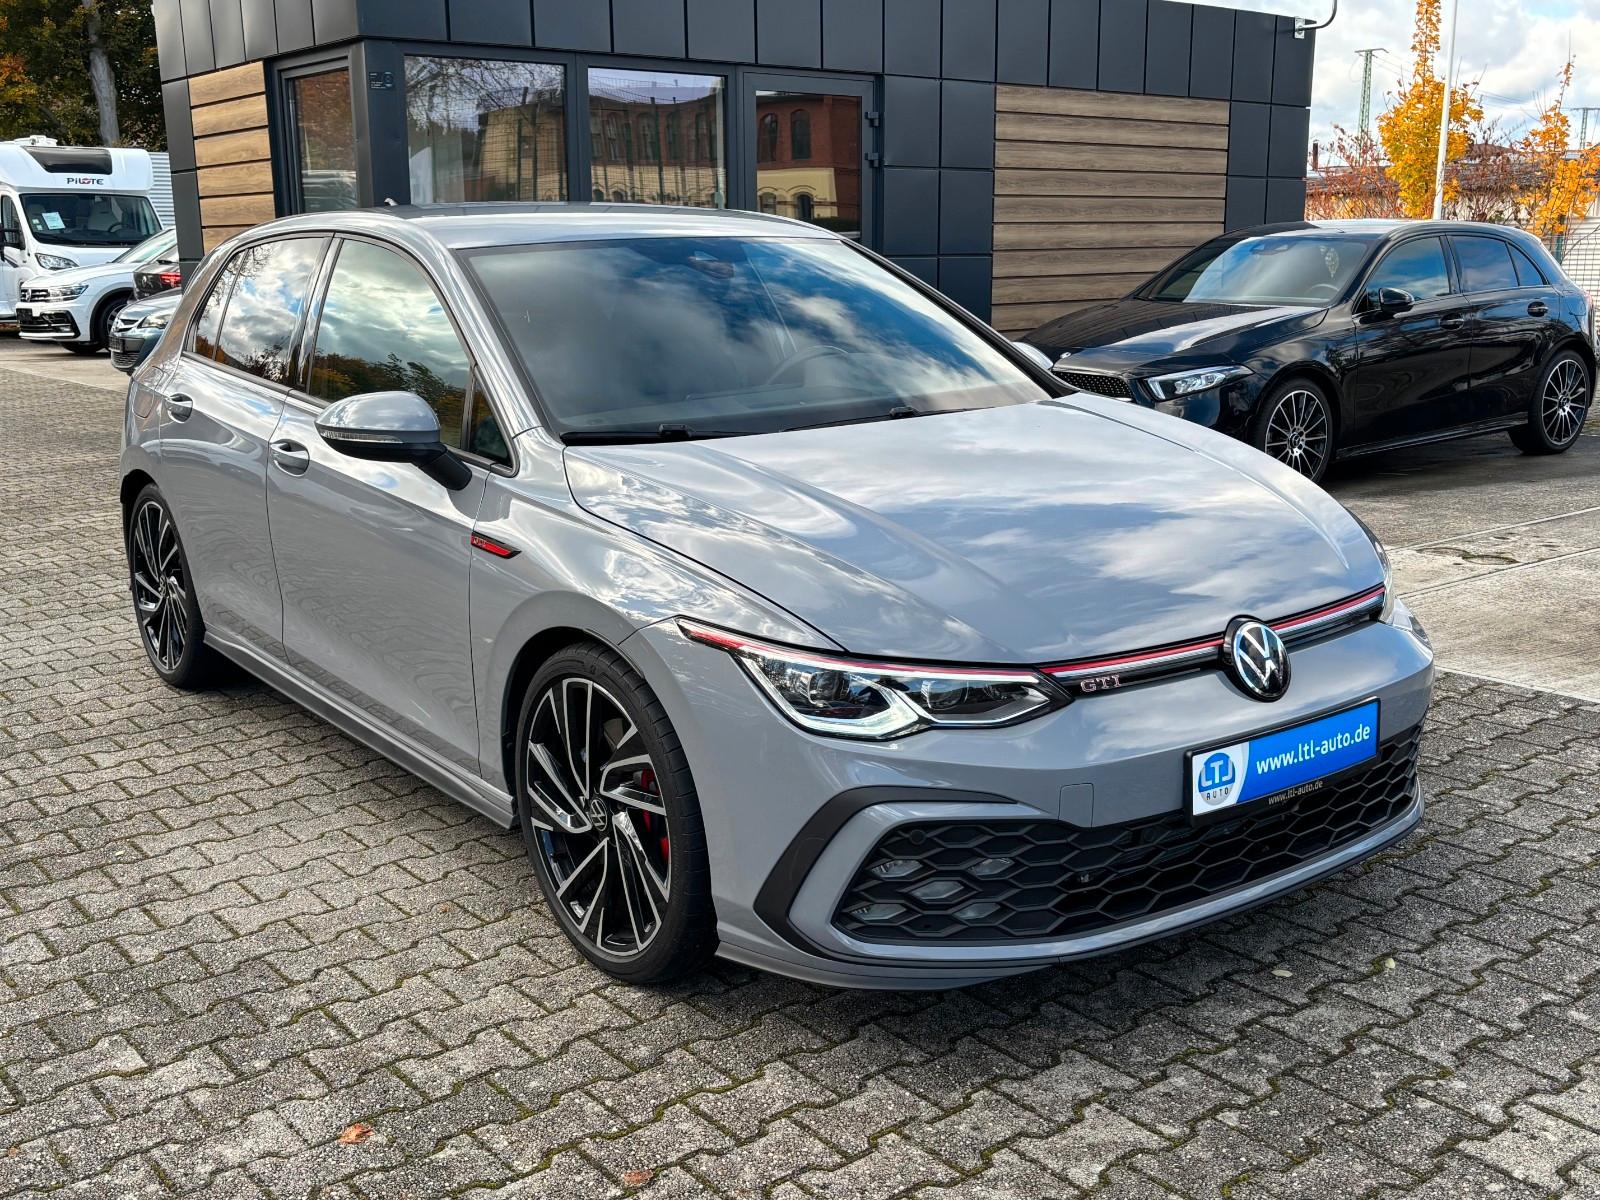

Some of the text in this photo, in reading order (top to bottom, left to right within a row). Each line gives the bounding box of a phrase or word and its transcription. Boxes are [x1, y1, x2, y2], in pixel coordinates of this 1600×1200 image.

[1080, 675, 1122, 692] GTI
[1256, 723, 1371, 774] www.ltl-auto.de
[1206, 787, 1229, 800] AUTO
[1268, 780, 1323, 805] www.ltl-auto.de
